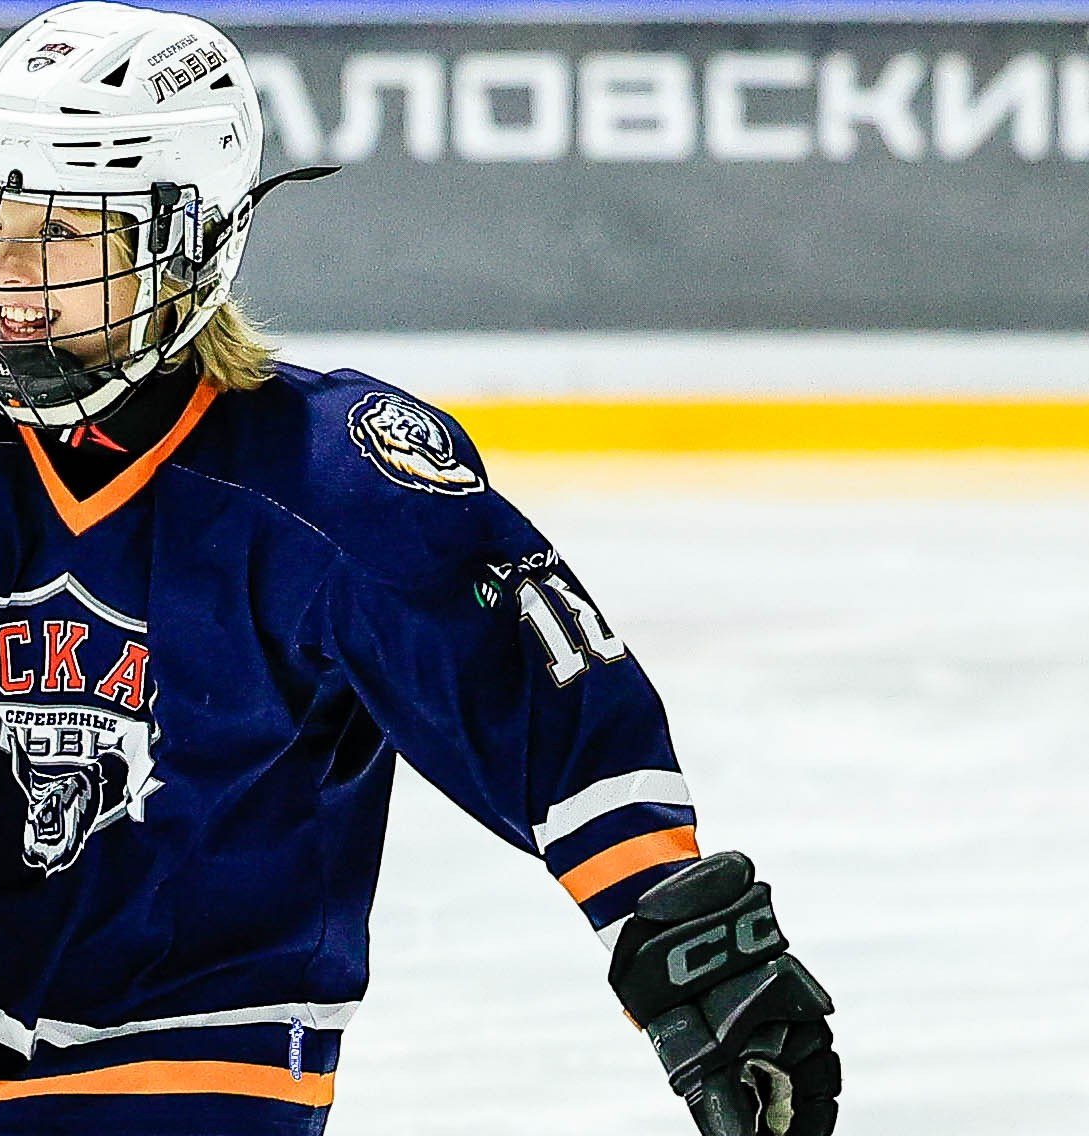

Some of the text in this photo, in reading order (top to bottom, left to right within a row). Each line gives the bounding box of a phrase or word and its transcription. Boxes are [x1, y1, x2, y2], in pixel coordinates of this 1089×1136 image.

[148, 41, 227, 104] ЛЬВЫ
[5, 709, 118, 733] СЕРЕБРЯНЫЕ
[667, 904, 781, 986] CC
